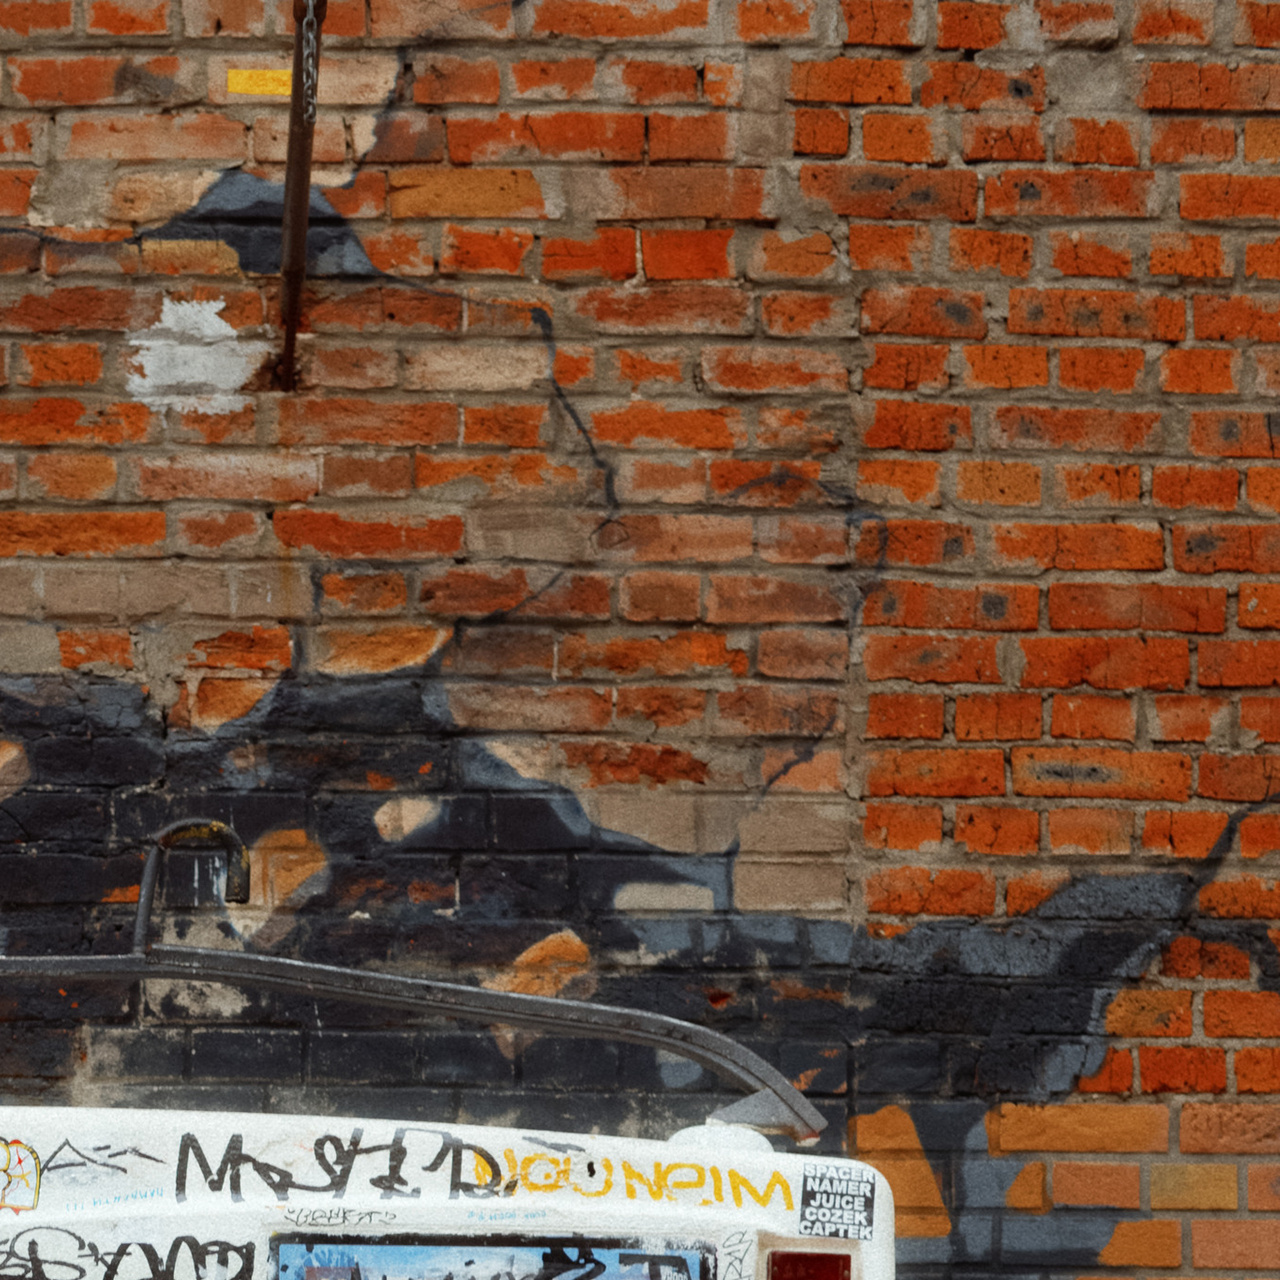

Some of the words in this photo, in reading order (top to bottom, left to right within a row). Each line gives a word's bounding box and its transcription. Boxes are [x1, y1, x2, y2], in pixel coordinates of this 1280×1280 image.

[804, 1164, 874, 1183] SPACER
[806, 1178, 872, 1198] NAMER
[810, 1193, 865, 1211] JUICE
[805, 1207, 868, 1225] COZEK
[799, 1220, 873, 1240] CAPTEK
